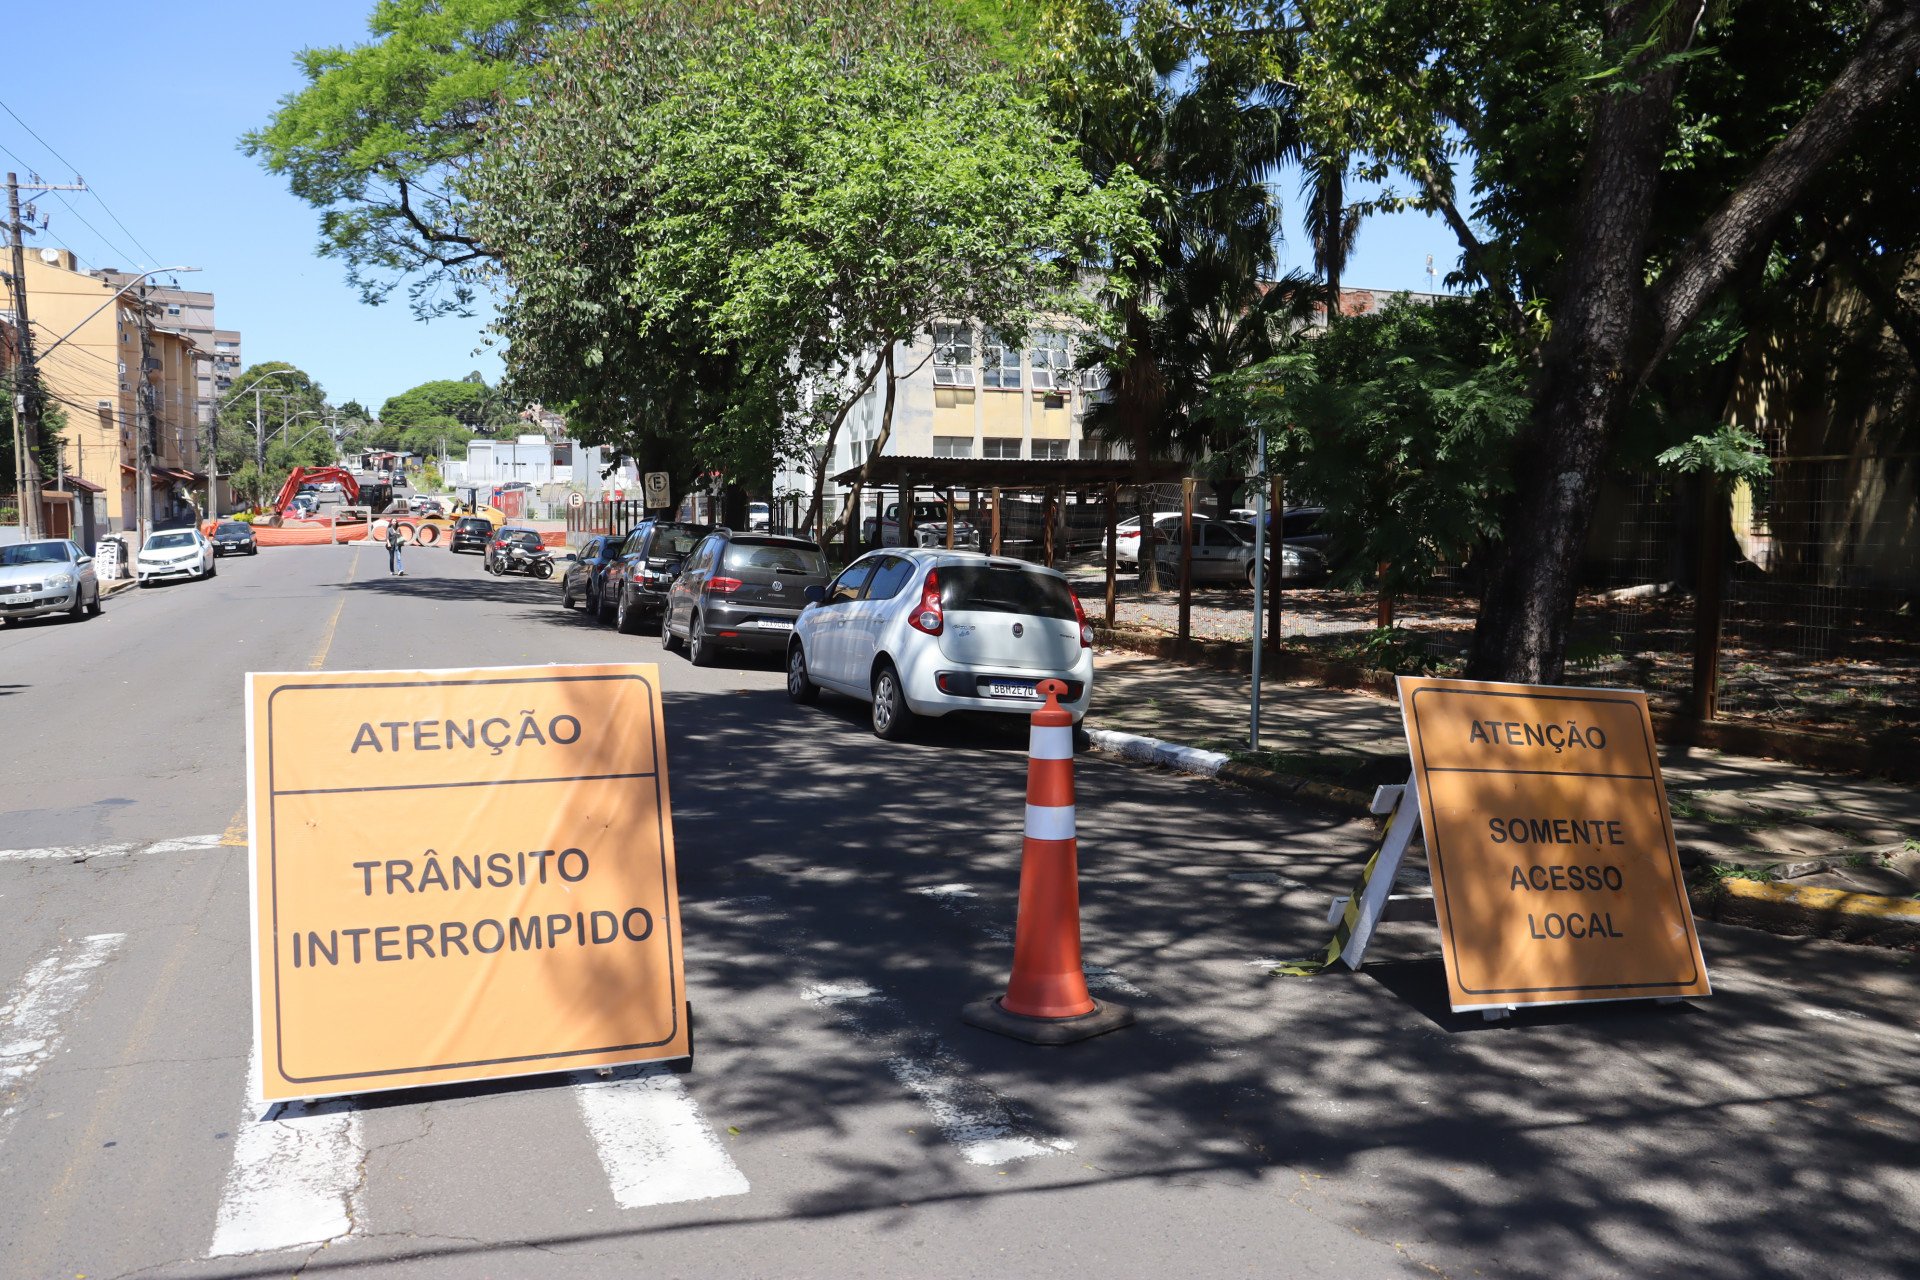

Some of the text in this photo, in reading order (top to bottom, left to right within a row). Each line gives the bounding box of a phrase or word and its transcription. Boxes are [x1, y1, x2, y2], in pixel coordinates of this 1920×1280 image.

[653, 476, 662, 490] E
[572, 494, 581, 506] E
[351, 709, 582, 756] ATENÇÃO
[1469, 720, 1606, 753] ATENÇÃO
[1489, 817, 1625, 845] SOMENTE
[353, 848, 590, 897] TRÂNSITO
[1510, 864, 1623, 892] ACESSO
[293, 907, 654, 969] INTERROMPIDO
[1528, 912, 1624, 940] LOCAL
